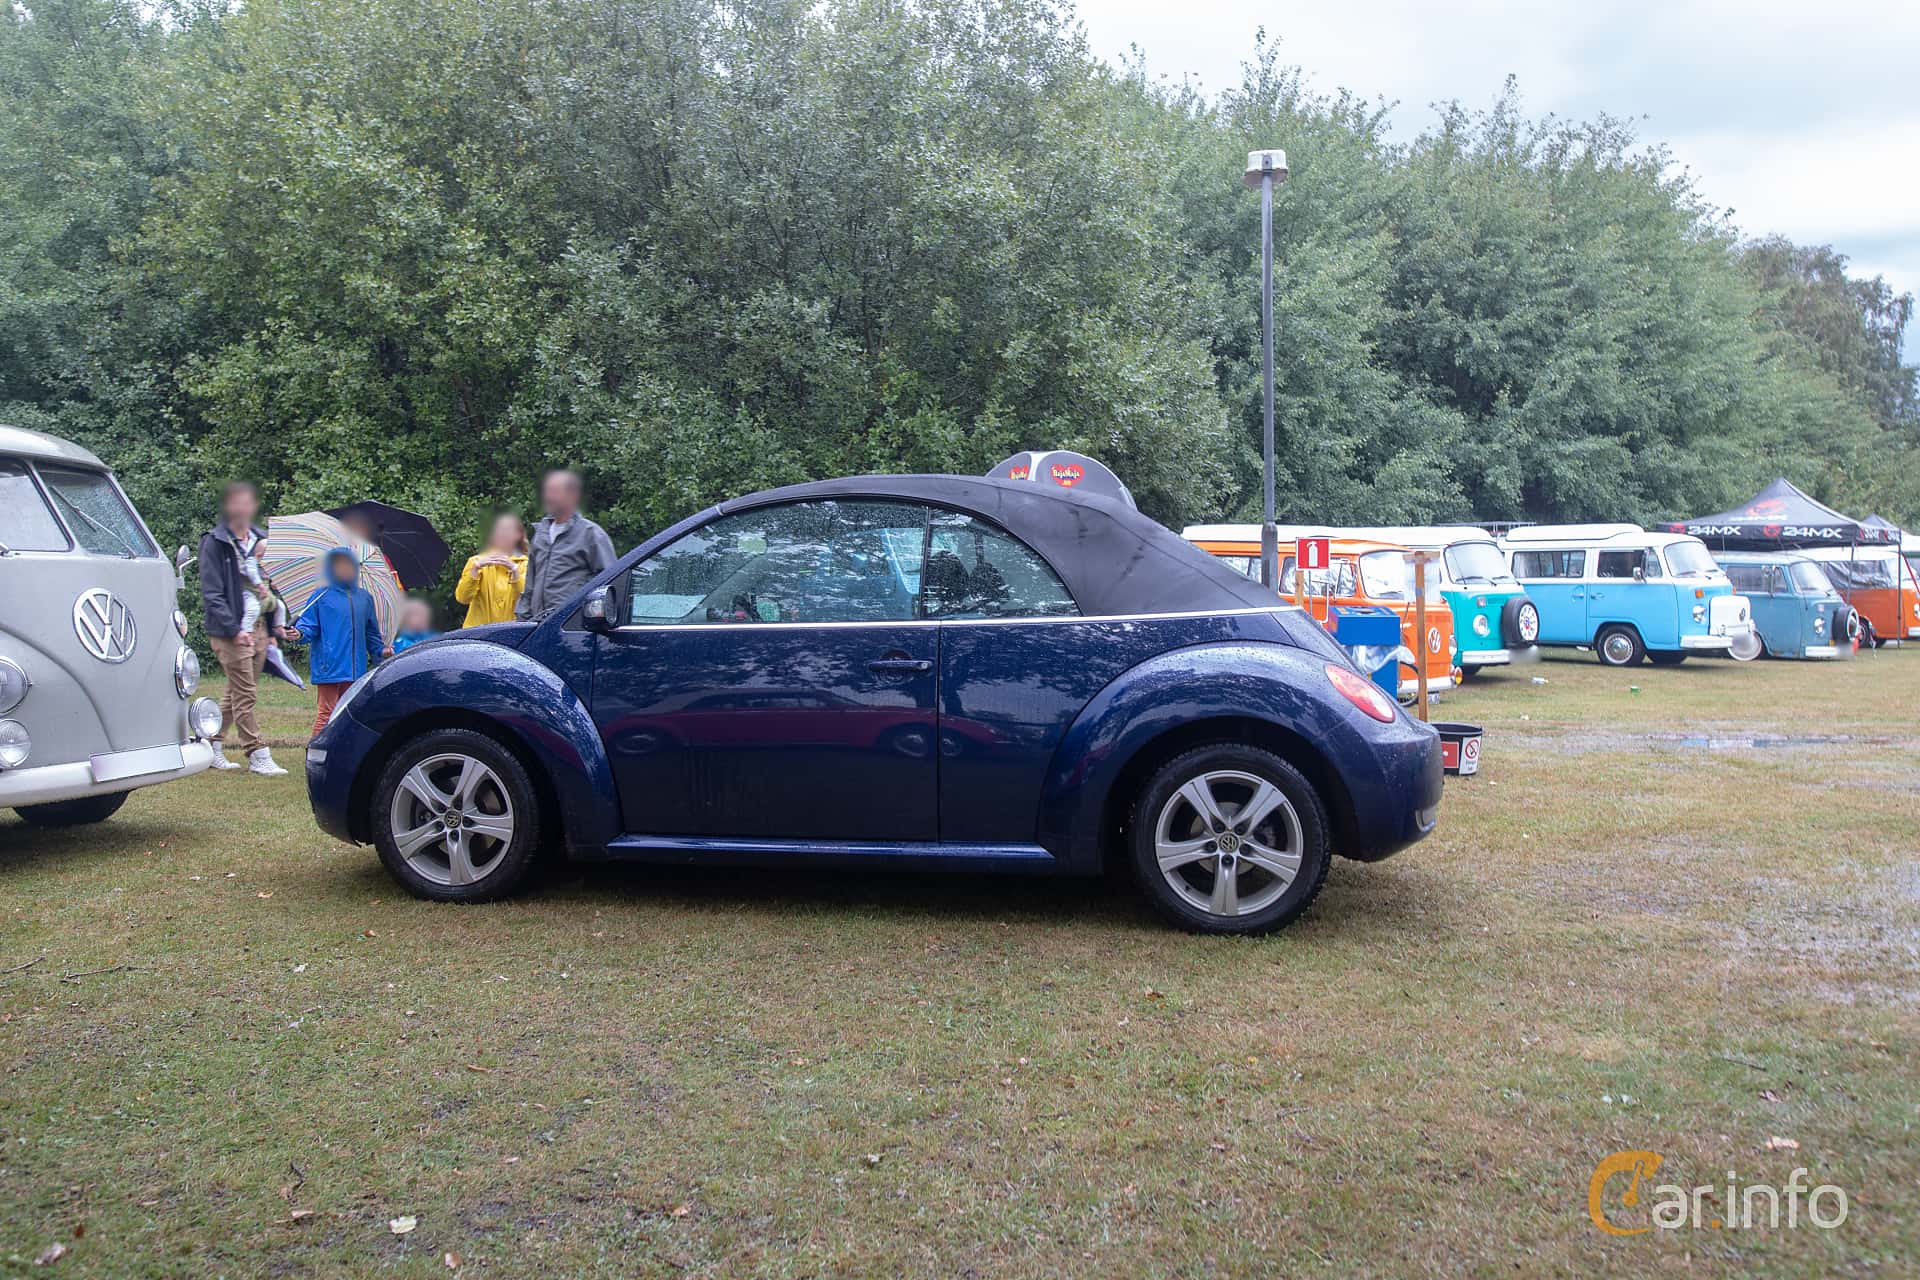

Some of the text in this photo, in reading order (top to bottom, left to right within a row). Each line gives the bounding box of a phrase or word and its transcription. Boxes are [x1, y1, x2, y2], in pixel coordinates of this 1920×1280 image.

[1687, 526, 1742, 536] 24MX
[1782, 525, 1843, 538] 24MX
[72, 587, 138, 664] VW
